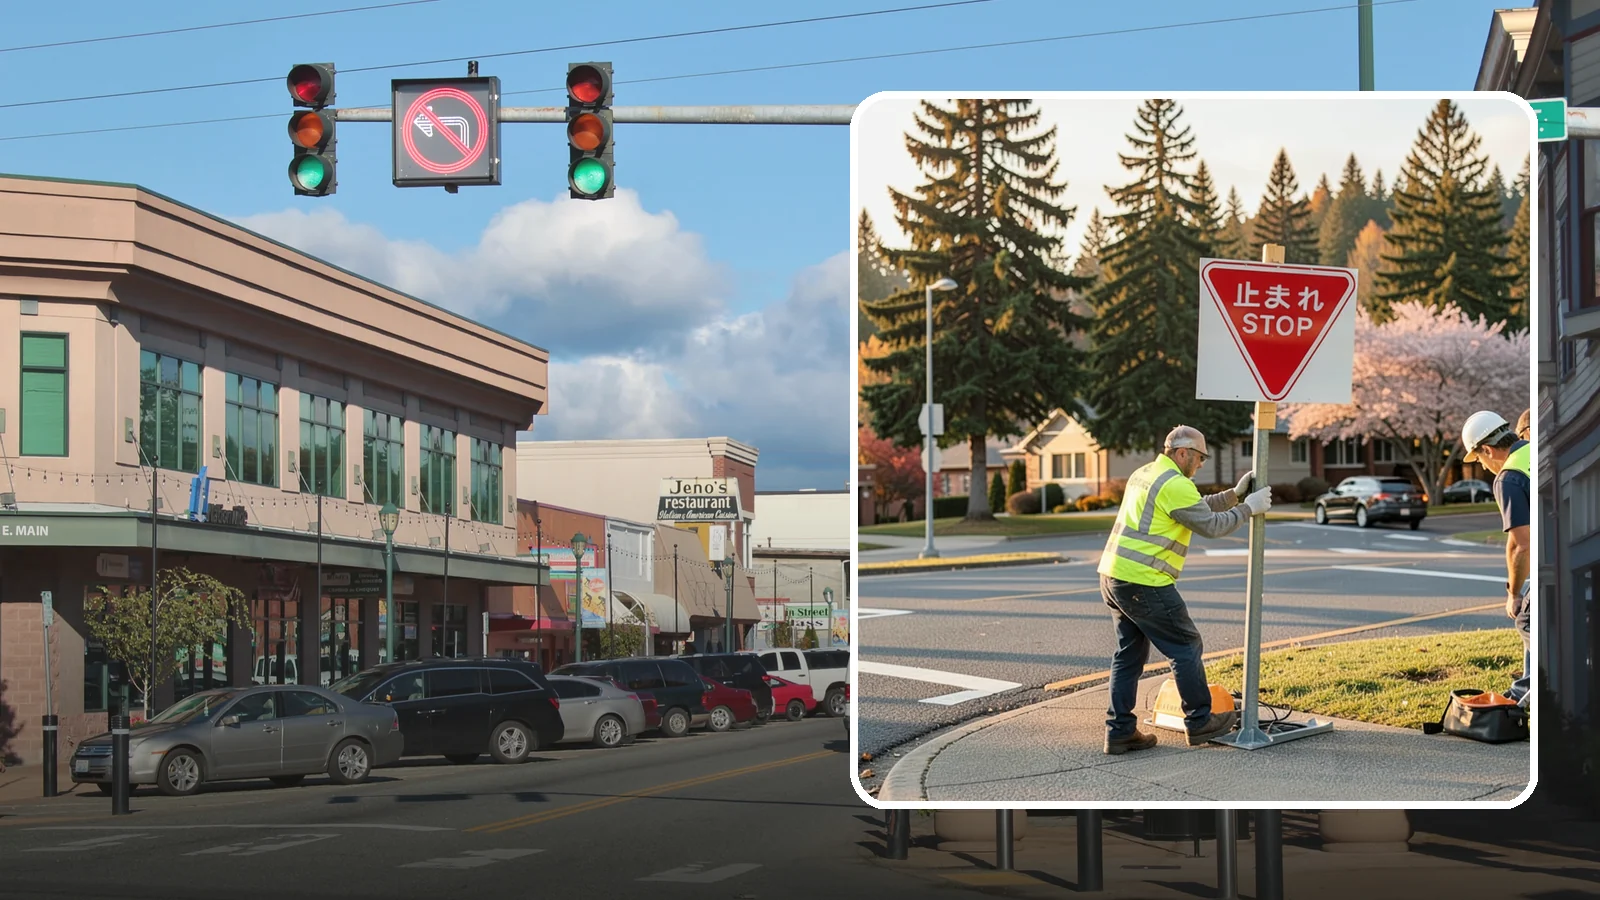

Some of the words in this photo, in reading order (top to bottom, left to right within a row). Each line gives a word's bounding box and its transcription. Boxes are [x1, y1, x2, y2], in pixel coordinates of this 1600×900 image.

[1233, 281, 1324, 312] 止まれ
[1242, 313, 1313, 337] STOP
[670, 480, 727, 494] Jeno's
[665, 496, 731, 509] restaurant
[658, 510, 682, 520] Italian
[686, 510, 714, 519] American
[715, 510, 738, 519] Cuisine
[2, 525, 13, 536] E.
[15, 525, 49, 536] MAIN
[797, 608, 828, 617] Street
